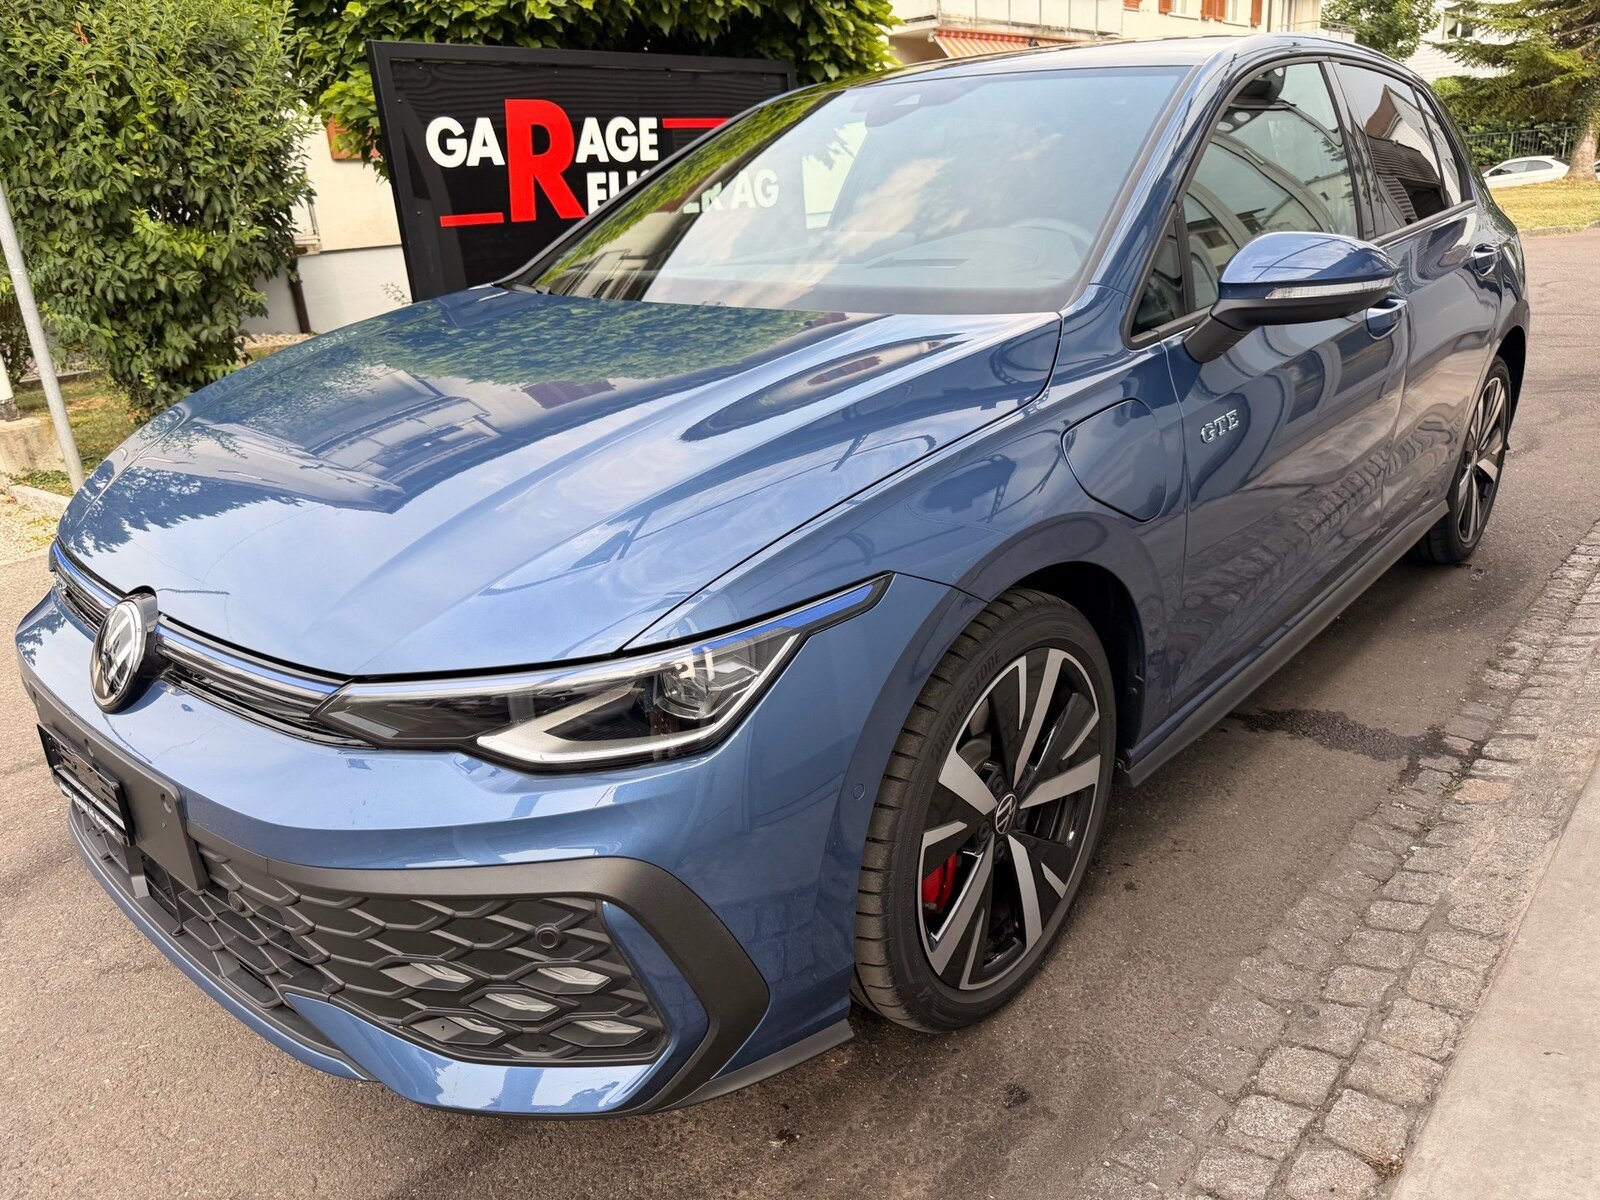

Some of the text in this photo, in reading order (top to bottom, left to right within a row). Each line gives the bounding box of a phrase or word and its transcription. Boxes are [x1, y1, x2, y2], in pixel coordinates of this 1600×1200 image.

[425, 98, 659, 222] GARAGE
[729, 168, 779, 210] AG
[1200, 409, 1239, 443] GTE
